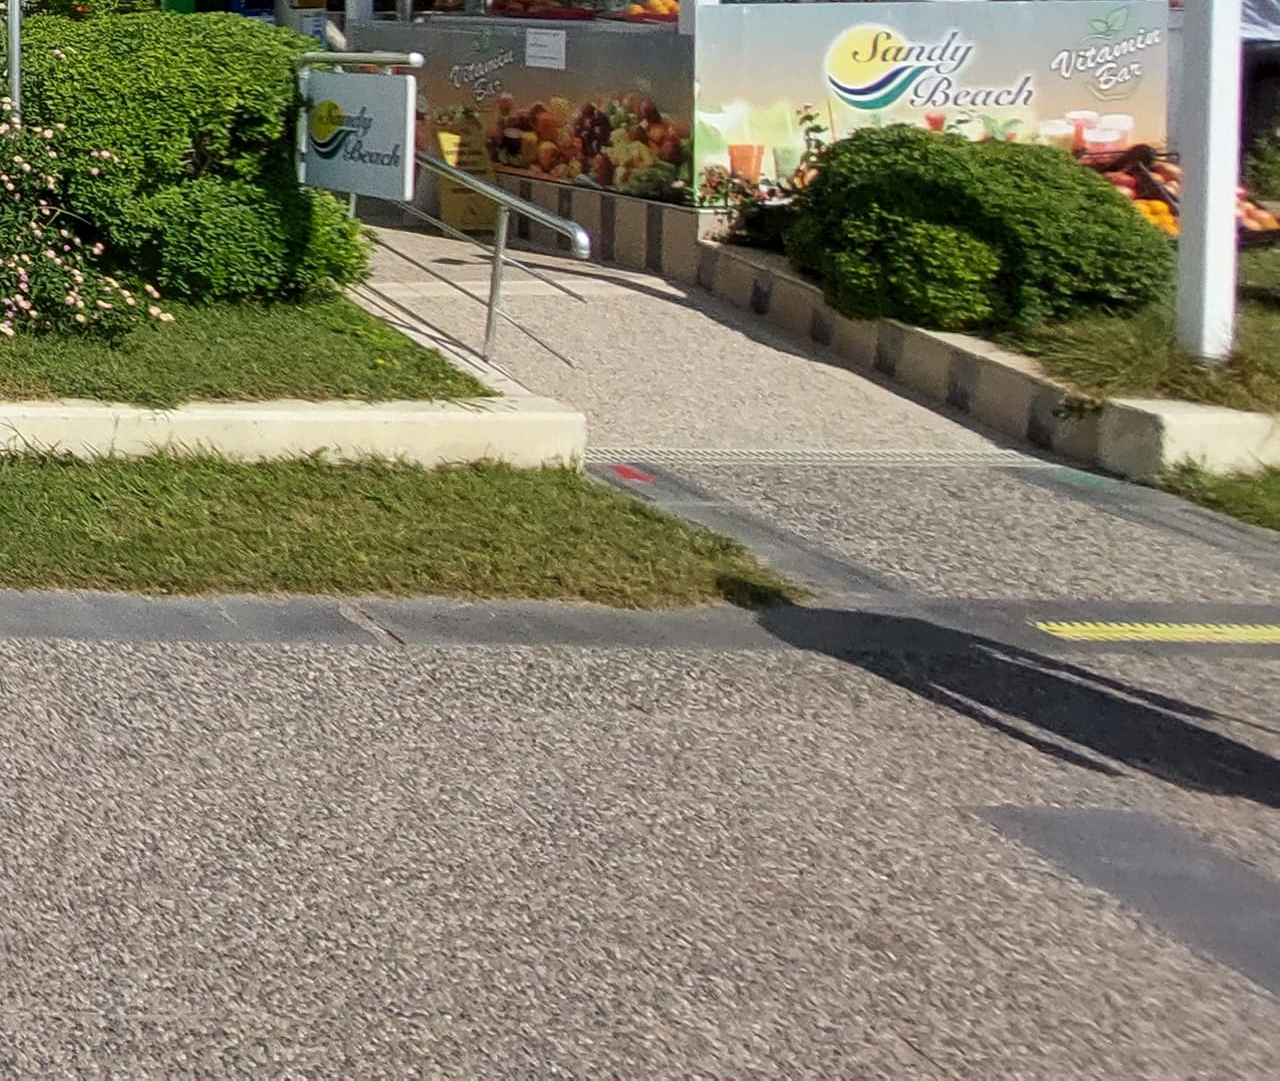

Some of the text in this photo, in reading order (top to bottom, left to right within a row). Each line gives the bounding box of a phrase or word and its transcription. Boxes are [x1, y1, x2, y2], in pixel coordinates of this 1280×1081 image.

[851, 30, 973, 74] Sandy
[1050, 26, 1161, 79] Vitamin
[909, 74, 1034, 107] Beach
[1093, 62, 1143, 90] Bar
